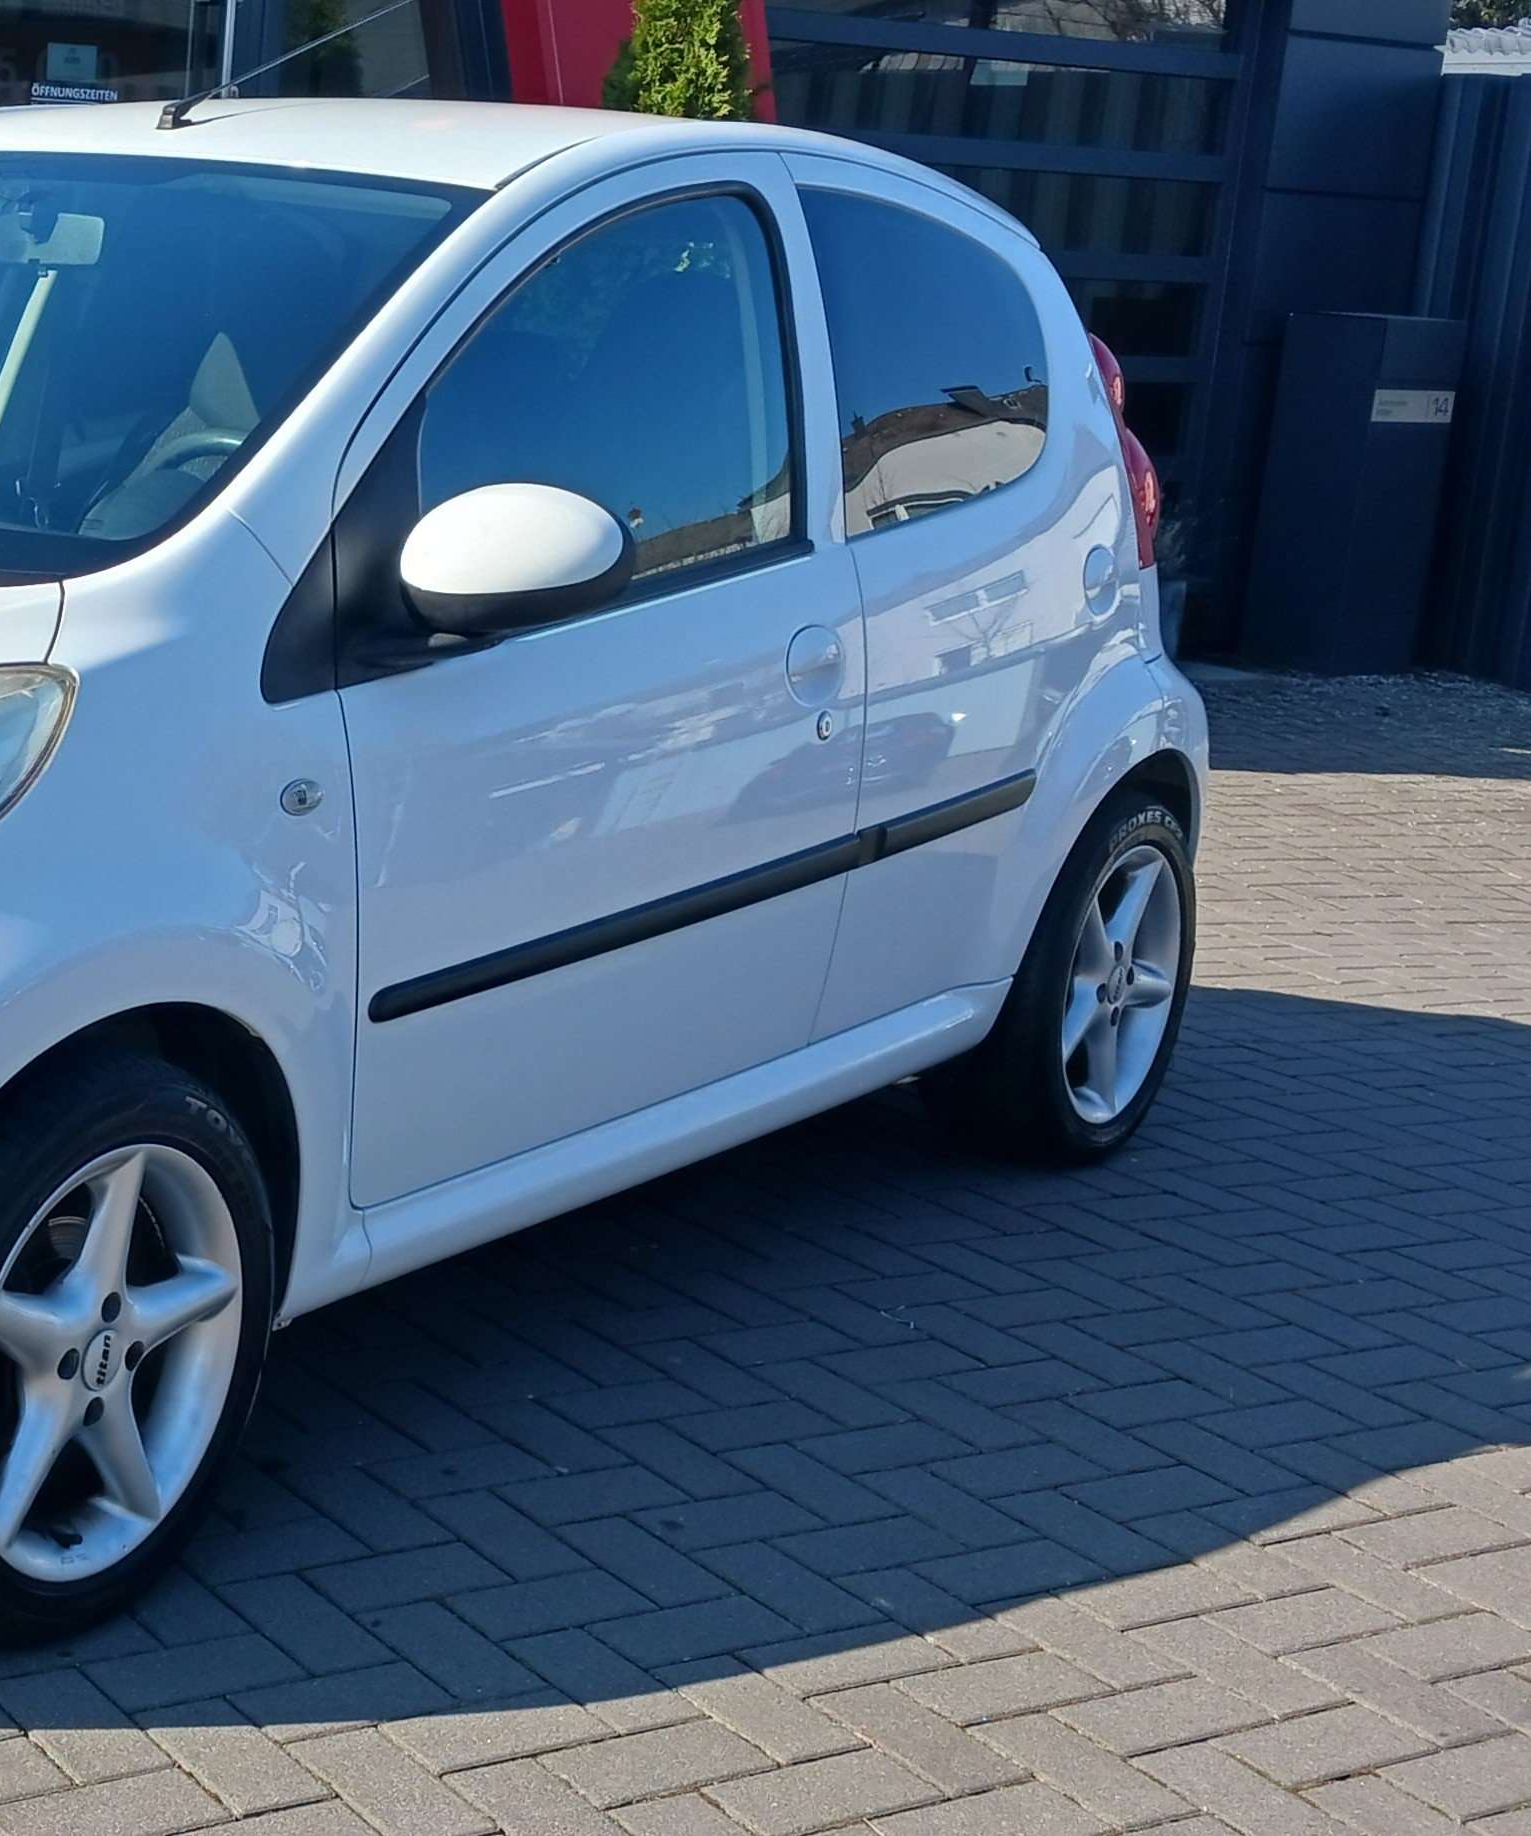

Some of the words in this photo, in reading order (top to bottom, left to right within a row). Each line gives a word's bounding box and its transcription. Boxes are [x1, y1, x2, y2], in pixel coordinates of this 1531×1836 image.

[31, 82, 118, 101] ÖFFNUNGSZEITEN
[1431, 397, 1450, 417] 14
[96, 1334, 112, 1386] titan
